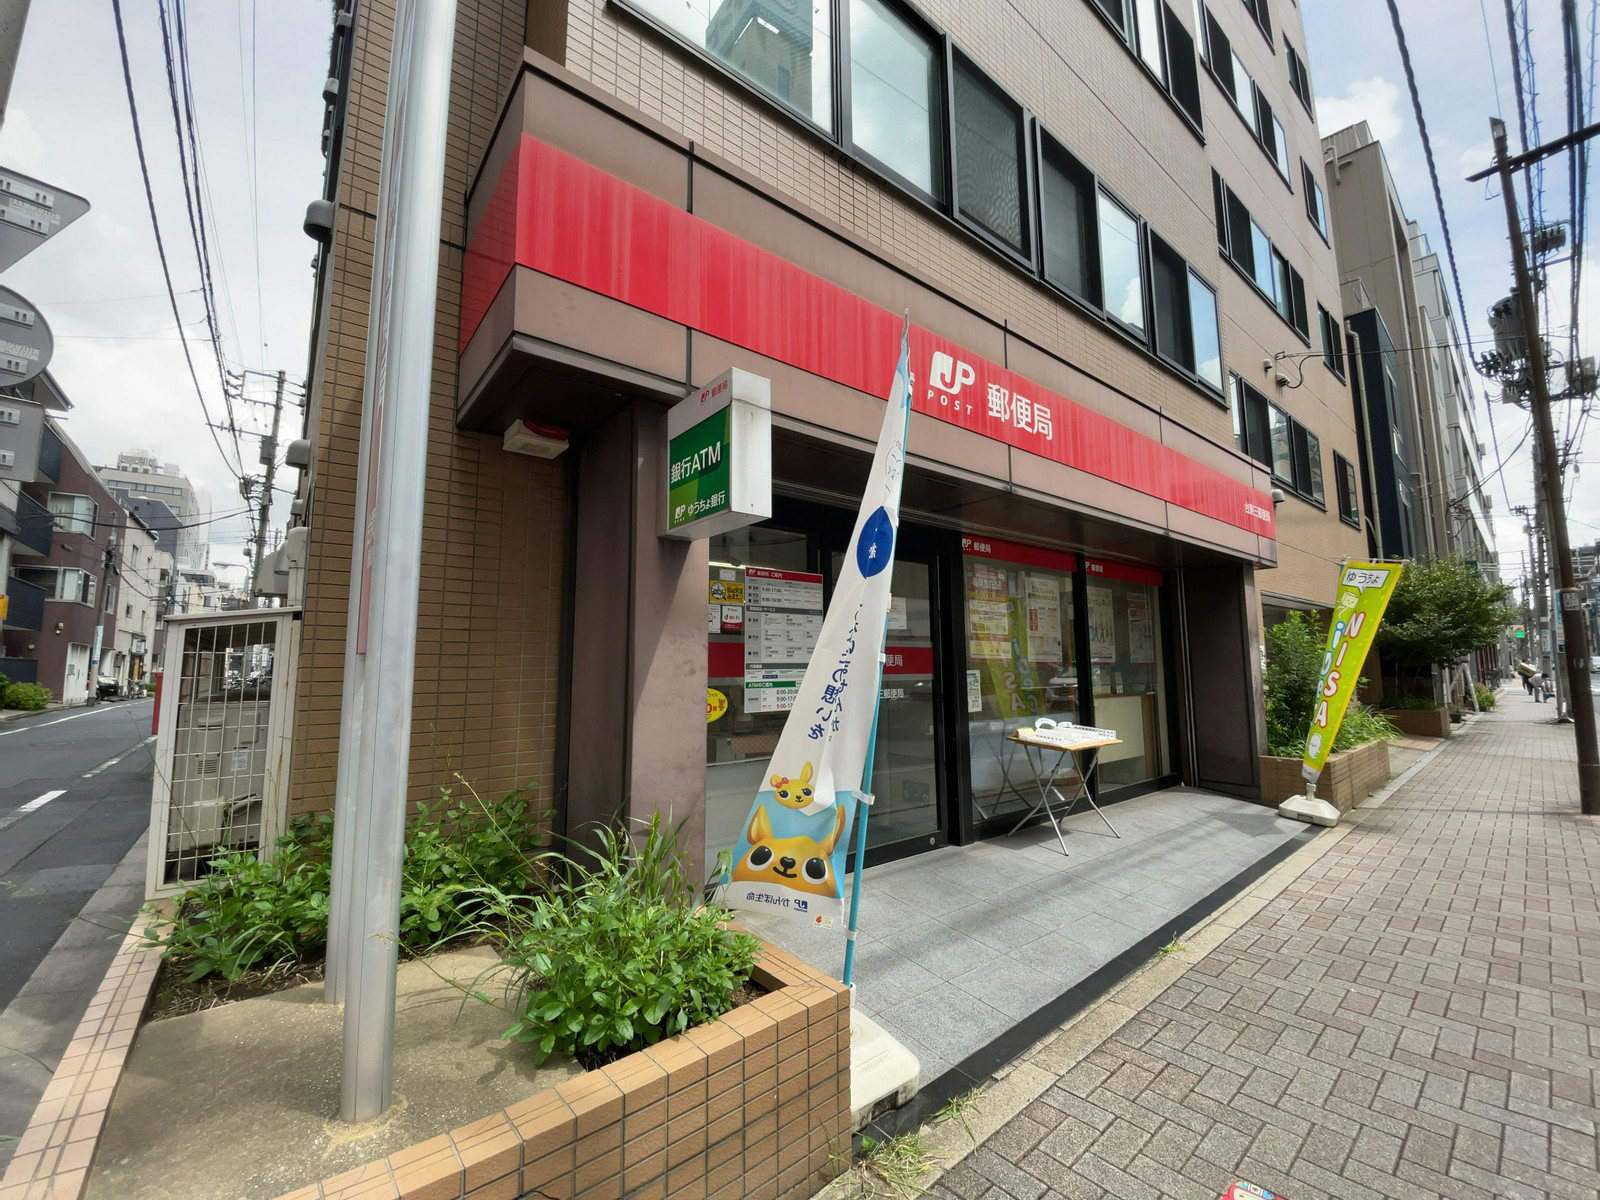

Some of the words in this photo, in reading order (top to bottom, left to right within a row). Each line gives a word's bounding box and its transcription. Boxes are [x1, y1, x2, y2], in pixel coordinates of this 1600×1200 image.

[711, 379, 728, 399] 郵便局
[927, 389, 973, 416] POST
[987, 382, 1053, 441] 郵便局
[670, 441, 721, 484] 銀行ATM
[687, 490, 726, 517] ゆうちょ銀行
[973, 542, 992, 554] 郵便局
[1346, 571, 1380, 585] ゆうちょ
[884, 655, 903, 667] 便局
[1315, 611, 1367, 728] NISA
